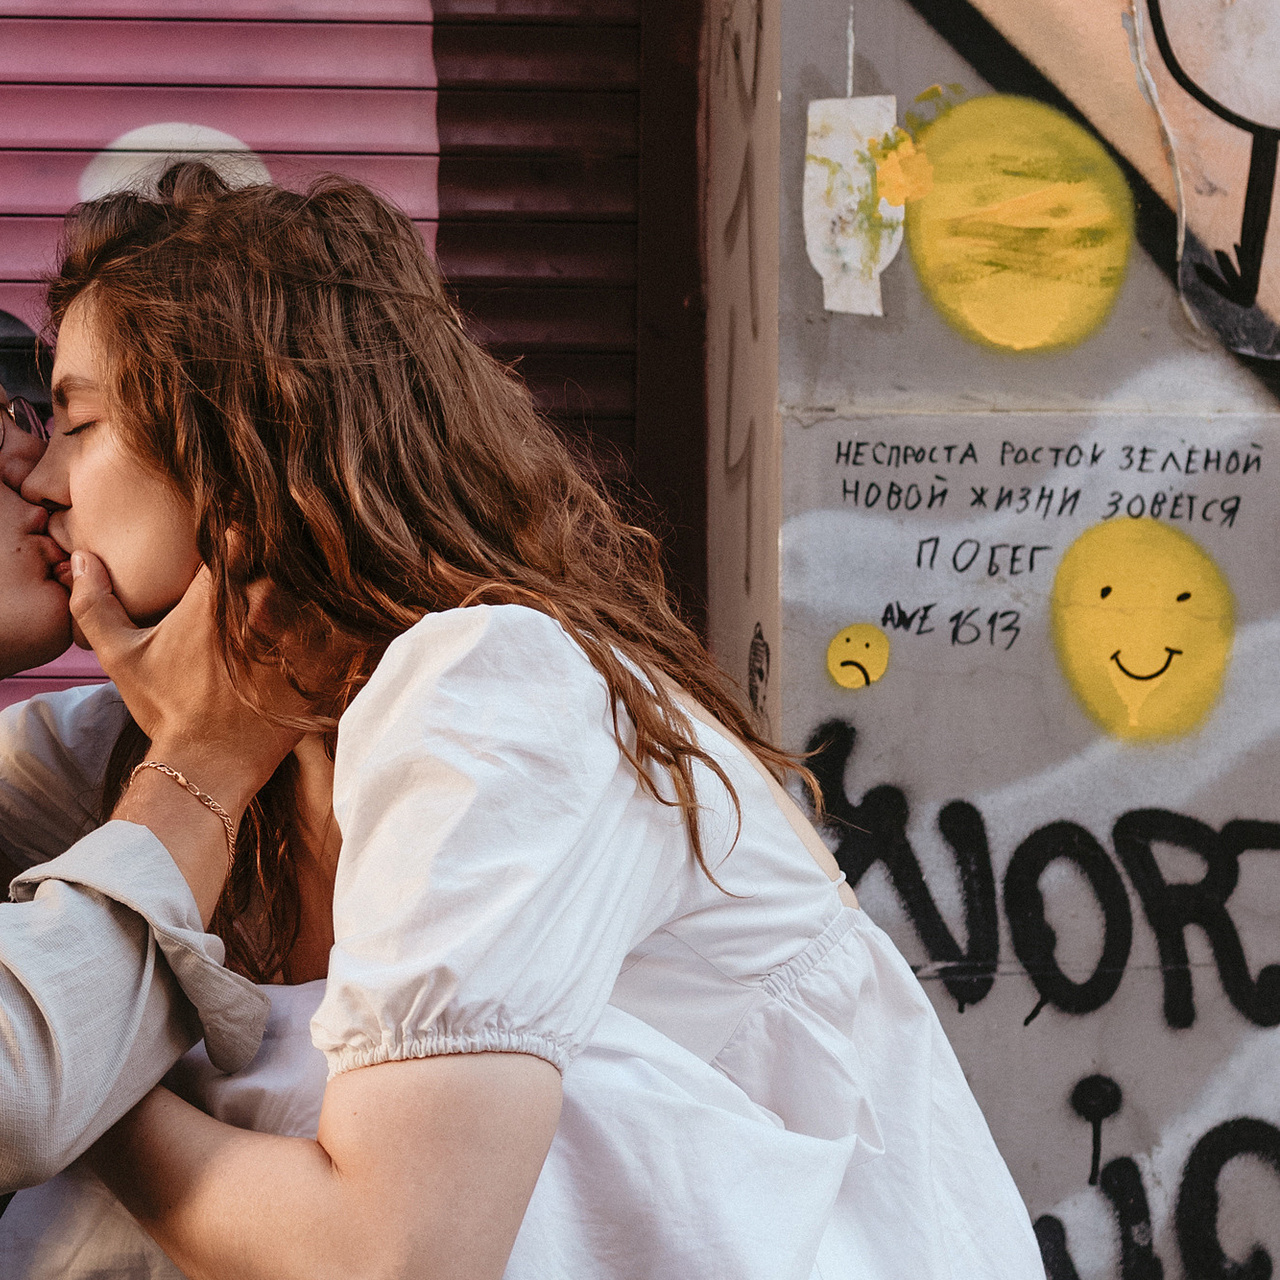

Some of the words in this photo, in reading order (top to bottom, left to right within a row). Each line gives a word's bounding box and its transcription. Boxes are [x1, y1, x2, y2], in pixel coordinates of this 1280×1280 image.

[835, 440, 978, 468] НЕСПРОСТА
[1000, 440, 1106, 469] РОСТОК
[841, 474, 949, 511] НОВОЙ
[970, 485, 1081, 520] ЖИЗНИ
[916, 536, 1053, 577] ПОБЕГ
